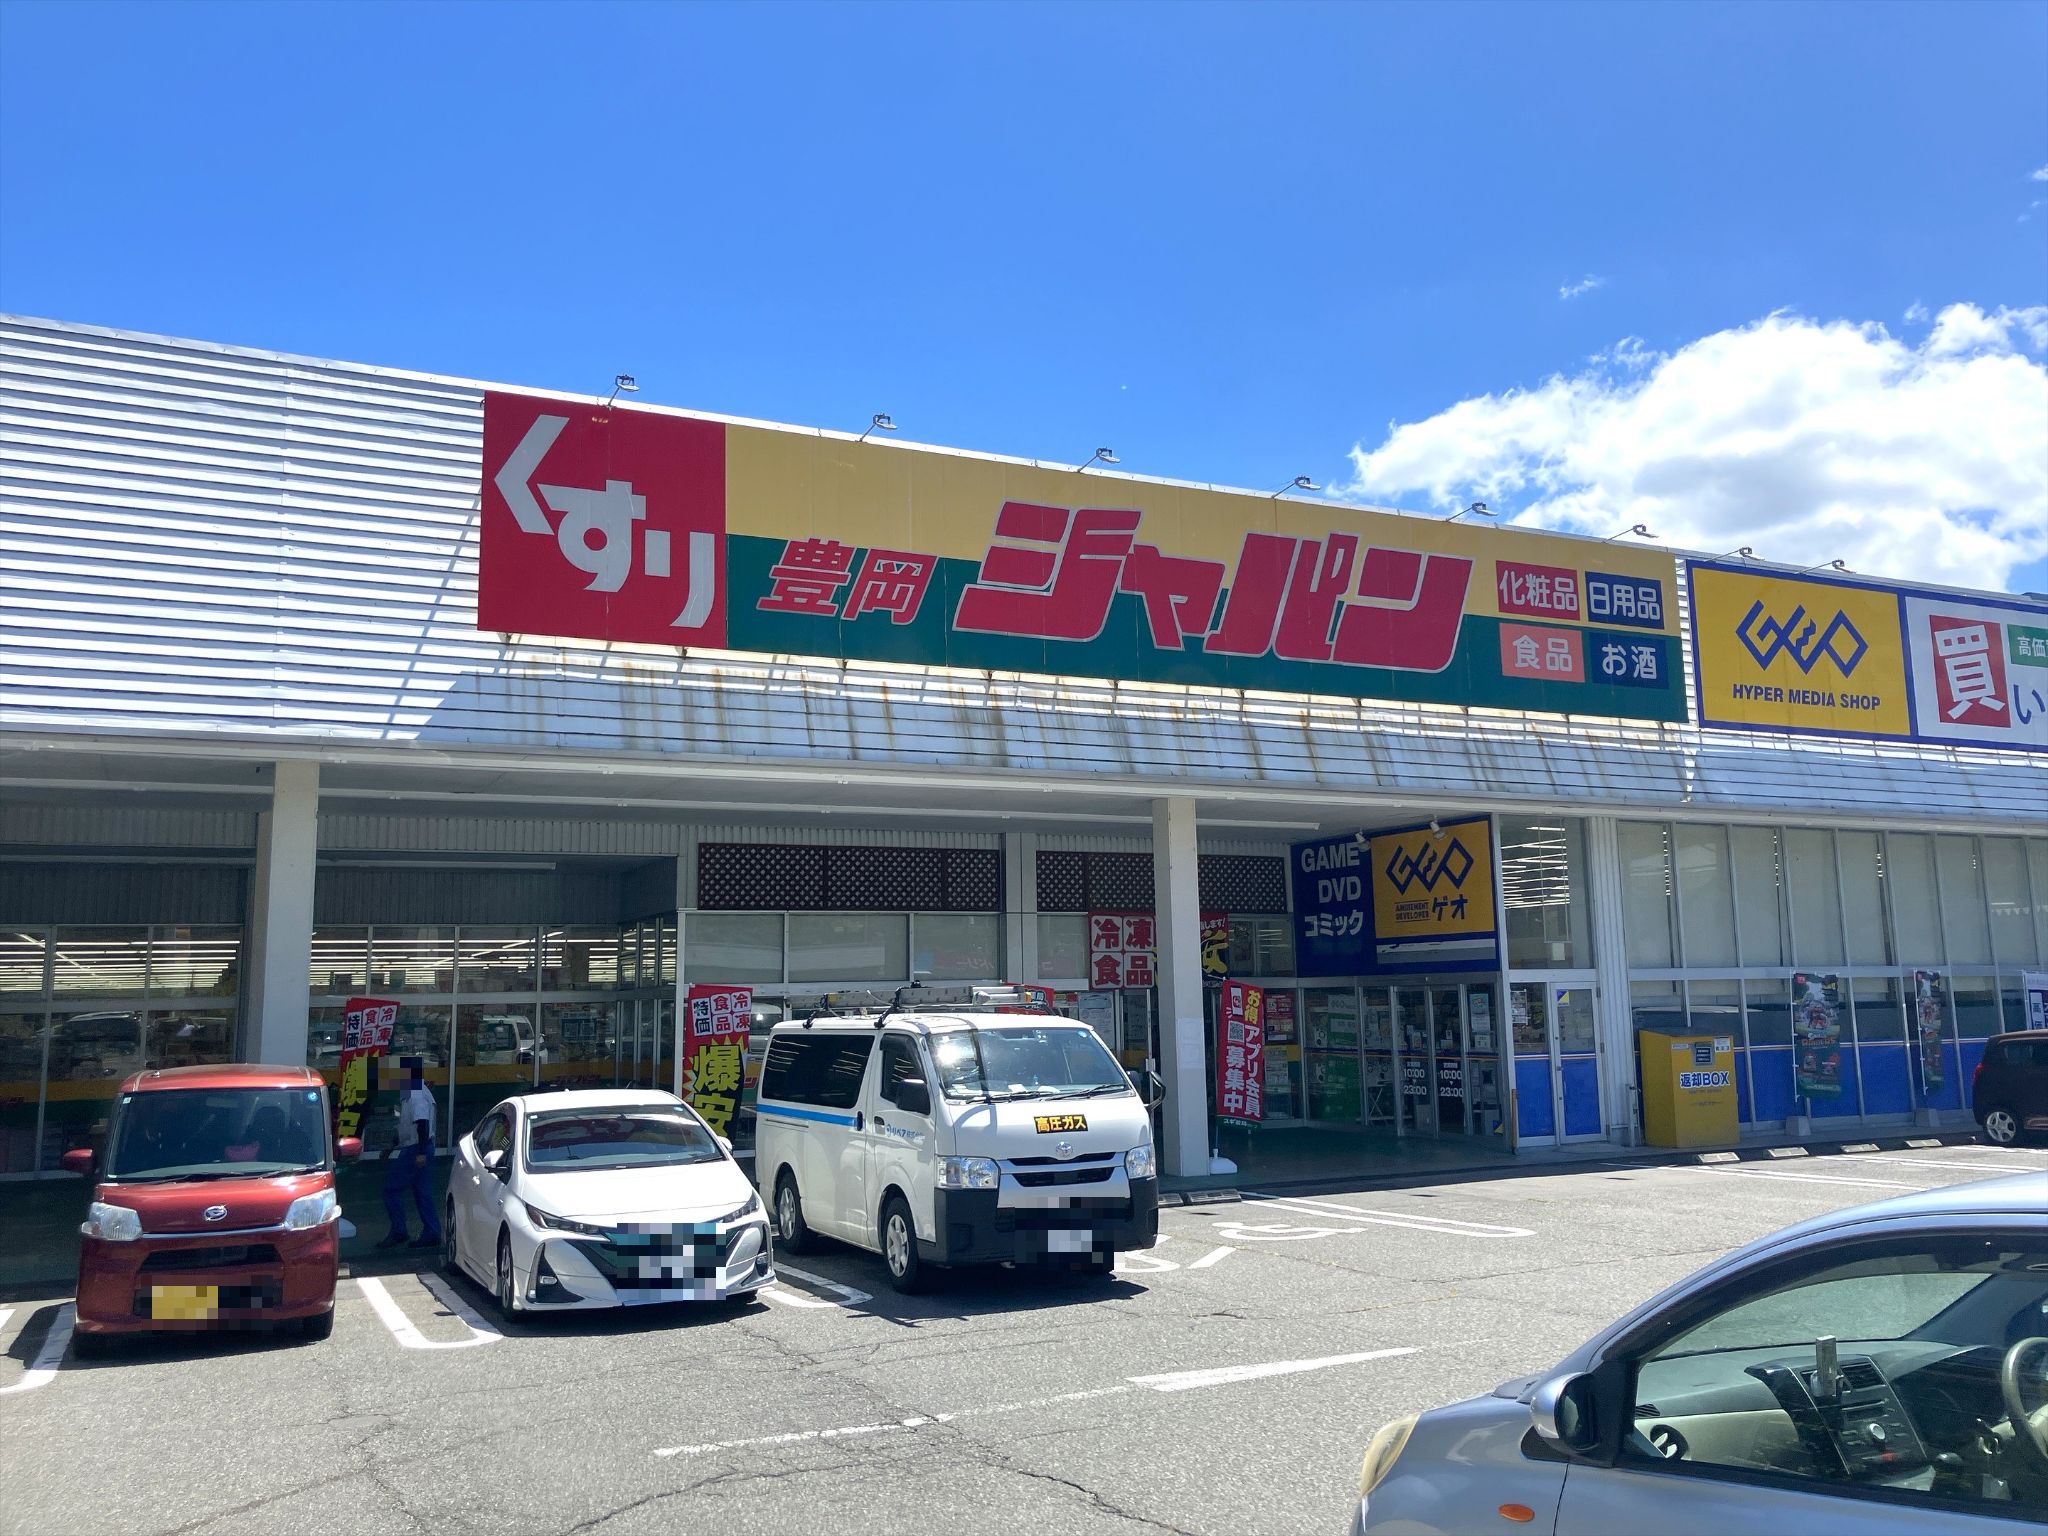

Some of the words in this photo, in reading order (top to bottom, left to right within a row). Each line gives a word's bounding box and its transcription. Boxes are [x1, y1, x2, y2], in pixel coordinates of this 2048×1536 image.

[494, 414, 715, 628] くすり
[756, 538, 939, 625] 豊岡
[952, 500, 1476, 673] ジャパン
[1499, 569, 1578, 613] 化粧品
[1589, 580, 1662, 621] 日用品
[1512, 634, 1574, 673] 食品
[1735, 600, 1868, 678] GEO
[2017, 636, 2048, 657] 高価
[1601, 643, 1658, 680] お酒
[1732, 684, 1784, 703] HYPER
[1788, 689, 1837, 707] MEDIA
[1840, 694, 1881, 710] SHOP
[1301, 842, 1361, 873] GAME
[1386, 837, 1474, 895] GEO
[1318, 876, 1362, 903] DVD
[1432, 894, 1468, 921] ゲオ
[1093, 919, 1152, 949] 冷凍
[1304, 910, 1364, 937] コミック
[1094, 954, 1152, 986] 食品
[693, 1000, 711, 1034] 特価
[714, 995, 731, 1032] 食品
[1223, 1045, 1246, 1114] 募集中
[1403, 1069, 1425, 1078] 10:00
[1440, 1070, 1462, 1080] 10:00
[1680, 1071, 1730, 1088] 返却BOX
[1403, 1085, 1427, 1095] 23:00
[1440, 1087, 1464, 1097] 23:00
[1036, 1116, 1087, 1132] 高圧ガス
